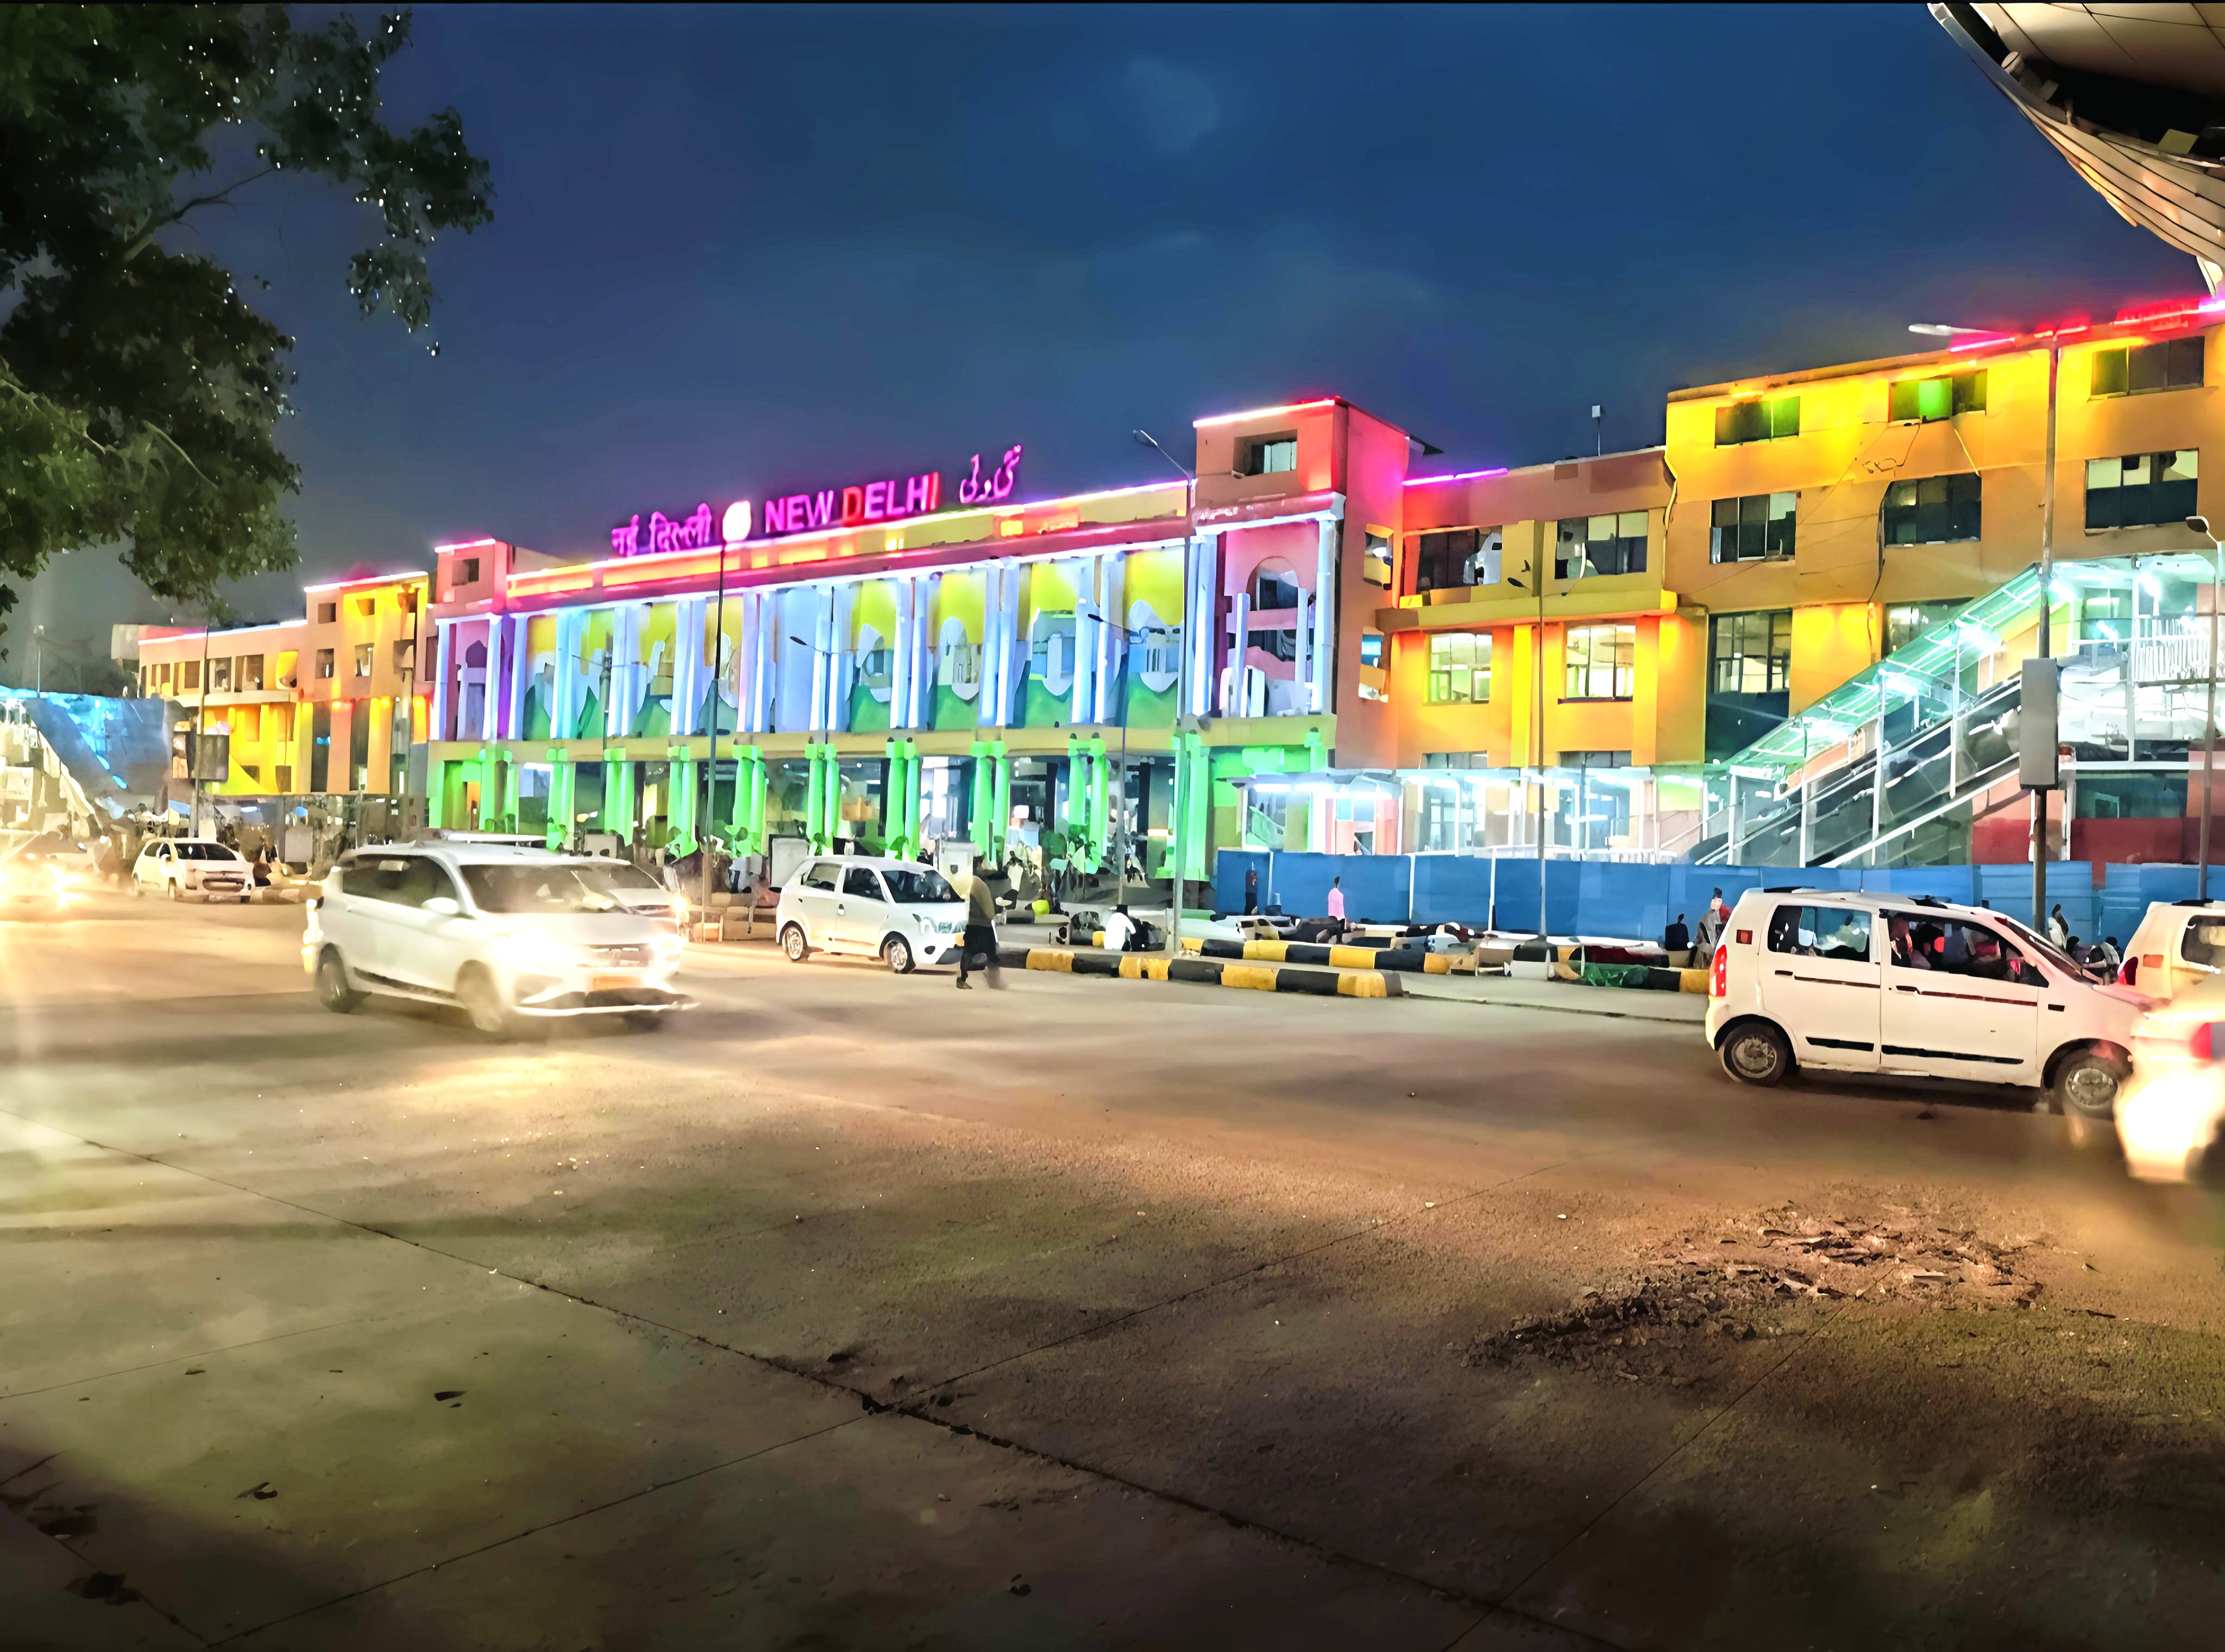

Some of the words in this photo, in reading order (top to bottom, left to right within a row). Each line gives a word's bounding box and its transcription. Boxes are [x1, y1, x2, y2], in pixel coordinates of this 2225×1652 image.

[765, 490, 834, 533] NEW
[843, 471, 939, 521] DELHI
[612, 514, 639, 557] नई
